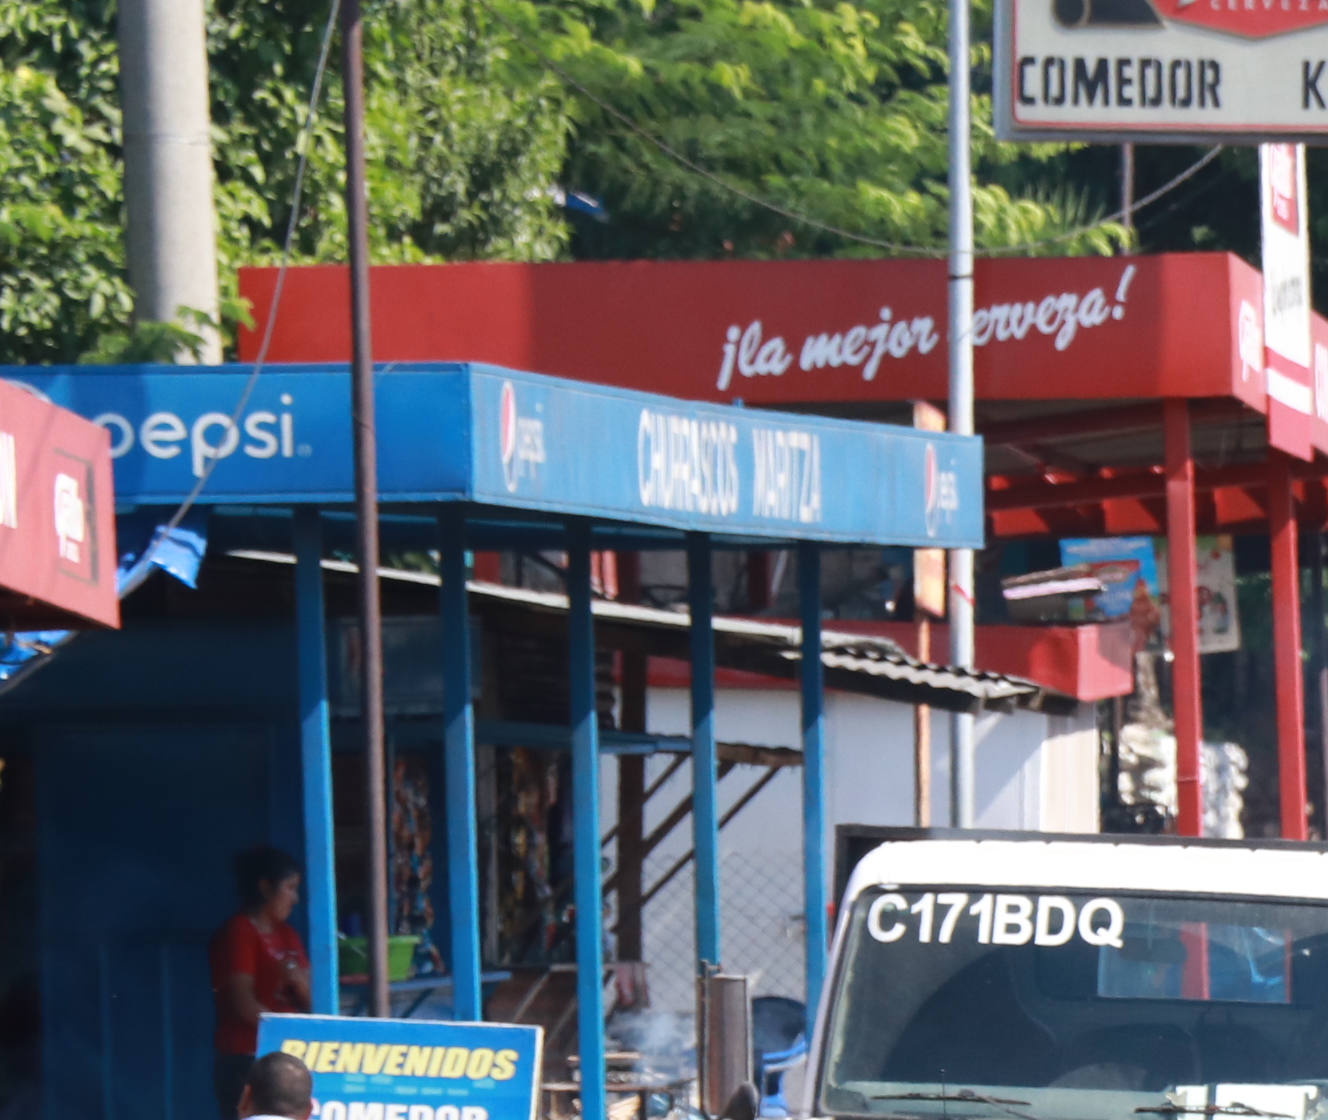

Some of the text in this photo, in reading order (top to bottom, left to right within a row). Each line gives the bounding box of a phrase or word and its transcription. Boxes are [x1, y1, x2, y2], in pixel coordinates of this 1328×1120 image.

[1017, 55, 1222, 110] COMEDOR
[800, 306, 939, 381] mejor
[970, 264, 1137, 351] erveza!
[866, 892, 1125, 949] C171BDQ
